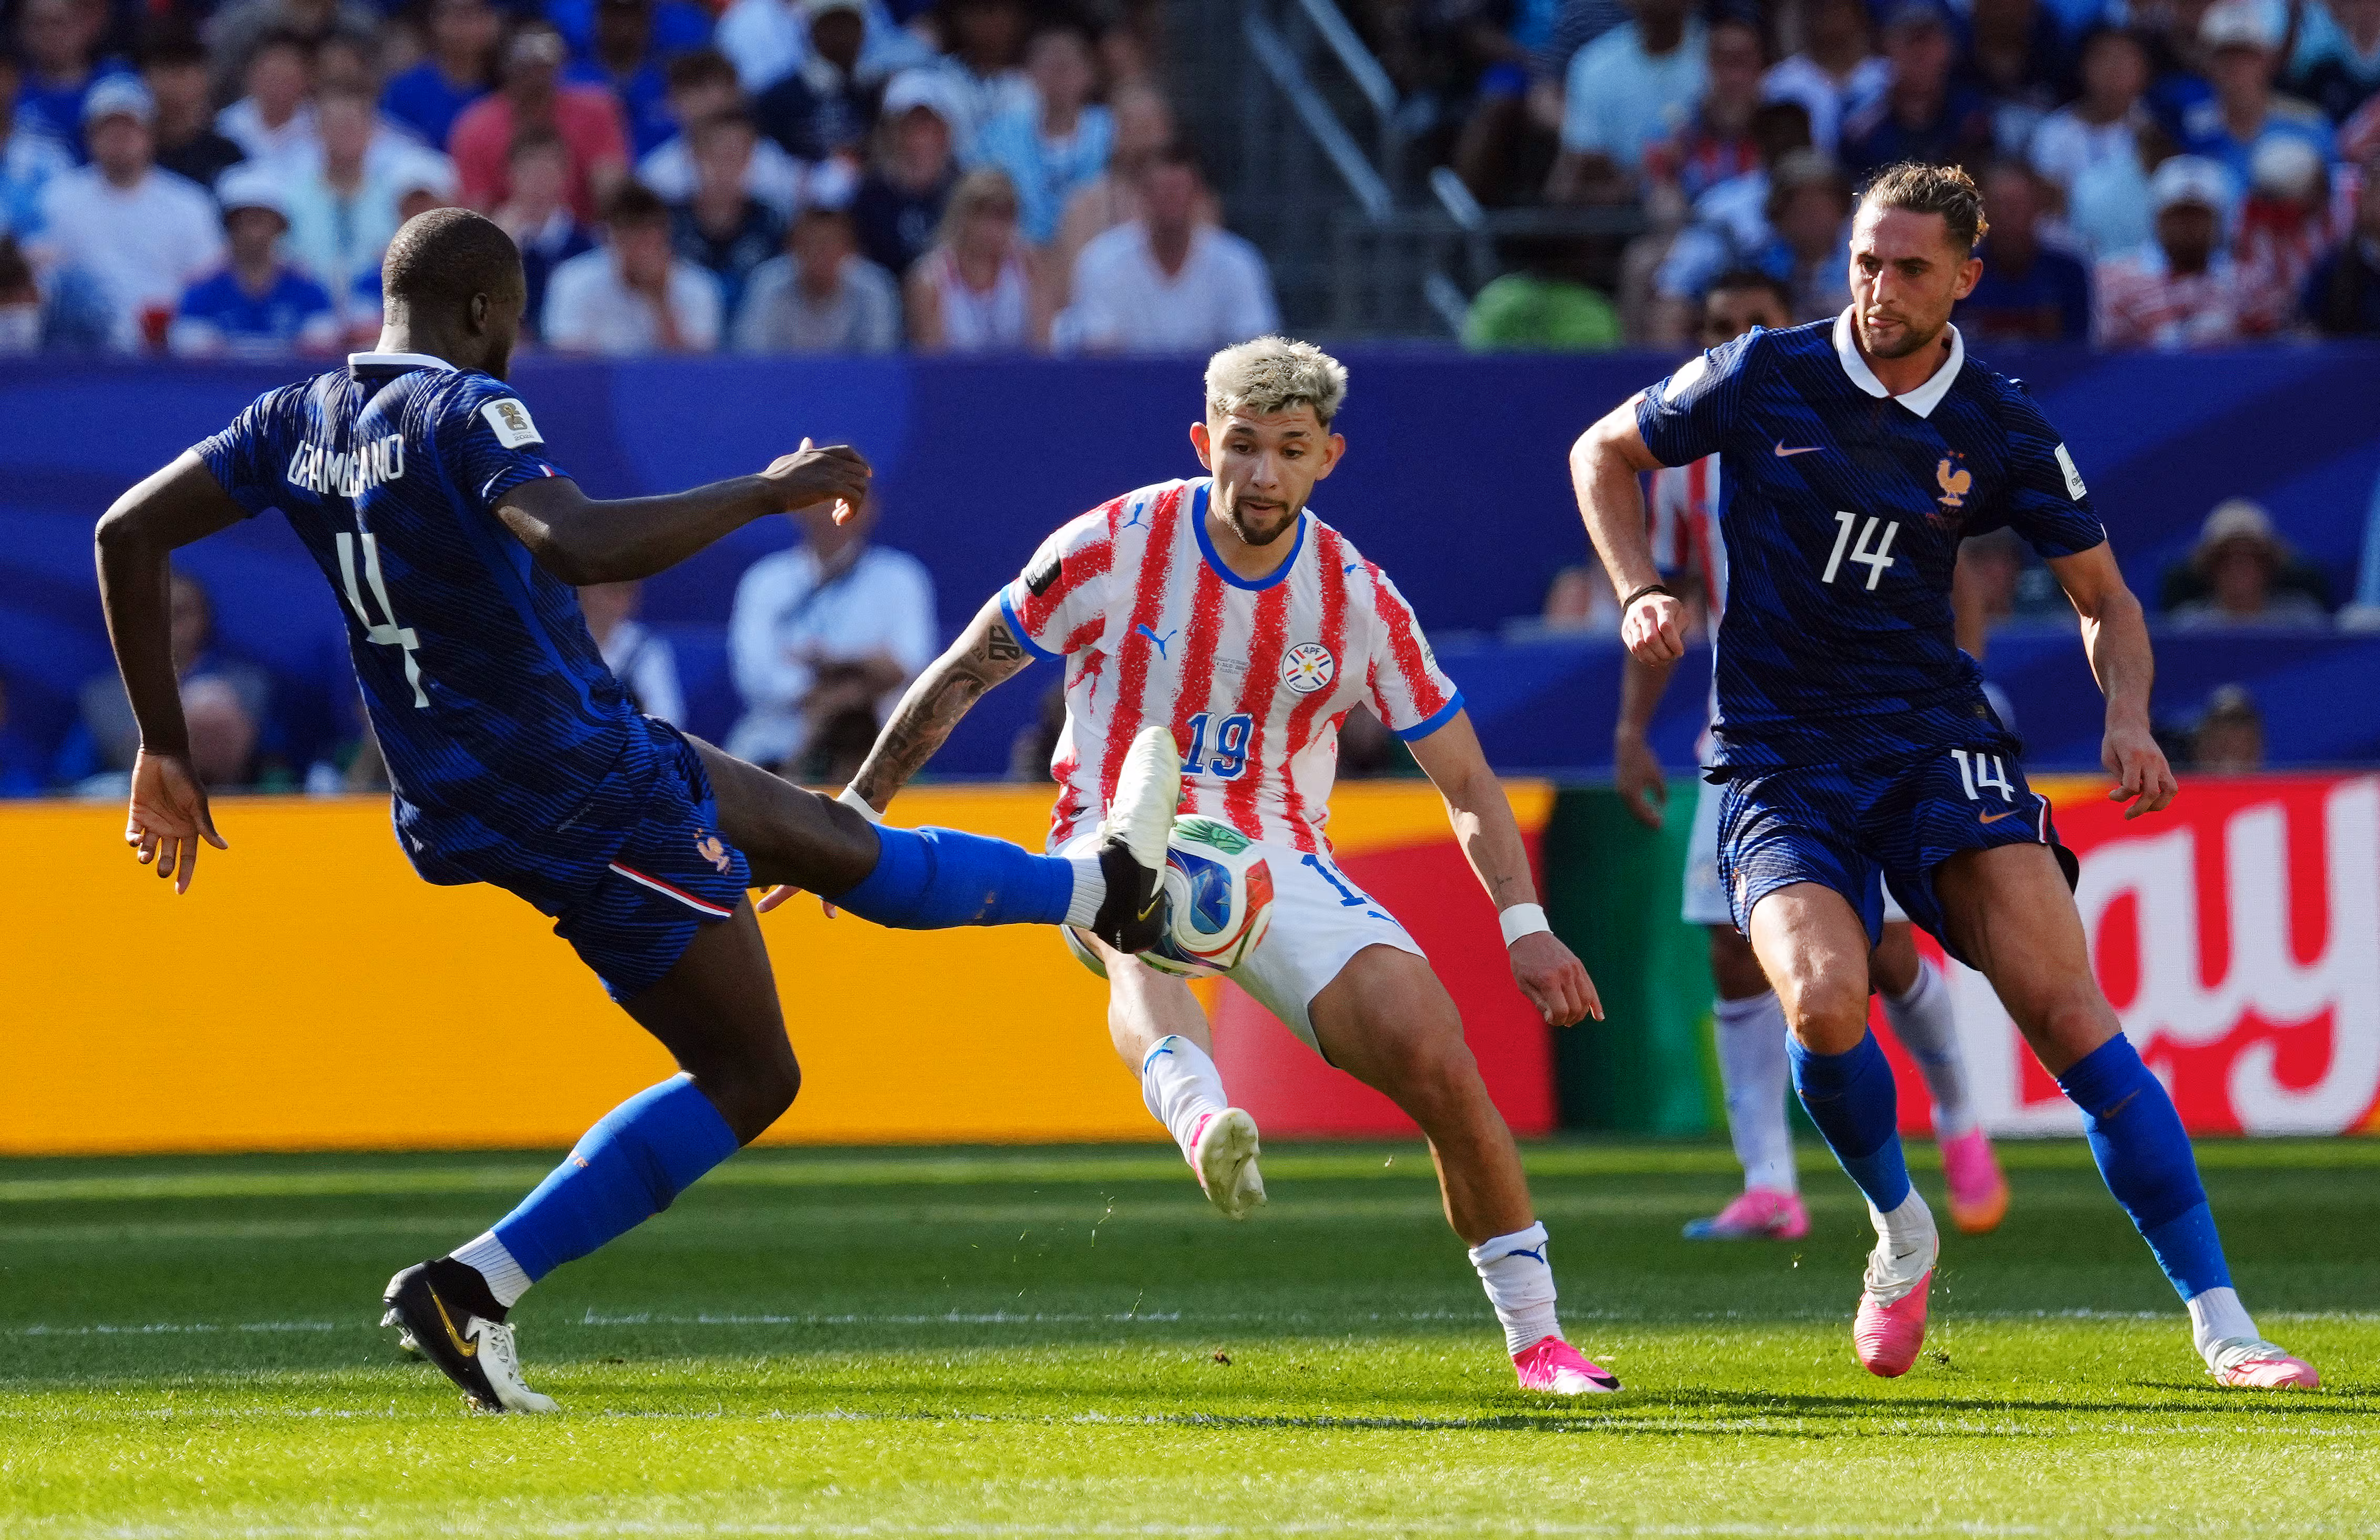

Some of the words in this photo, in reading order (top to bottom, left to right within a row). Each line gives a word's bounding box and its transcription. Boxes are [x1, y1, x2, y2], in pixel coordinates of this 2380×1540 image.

[1822, 511, 1899, 591] 14
[336, 532, 430, 708] 4
[1302, 647, 1321, 655] APF
[1182, 712, 1253, 781] 19
[1950, 749, 2015, 802] 14
